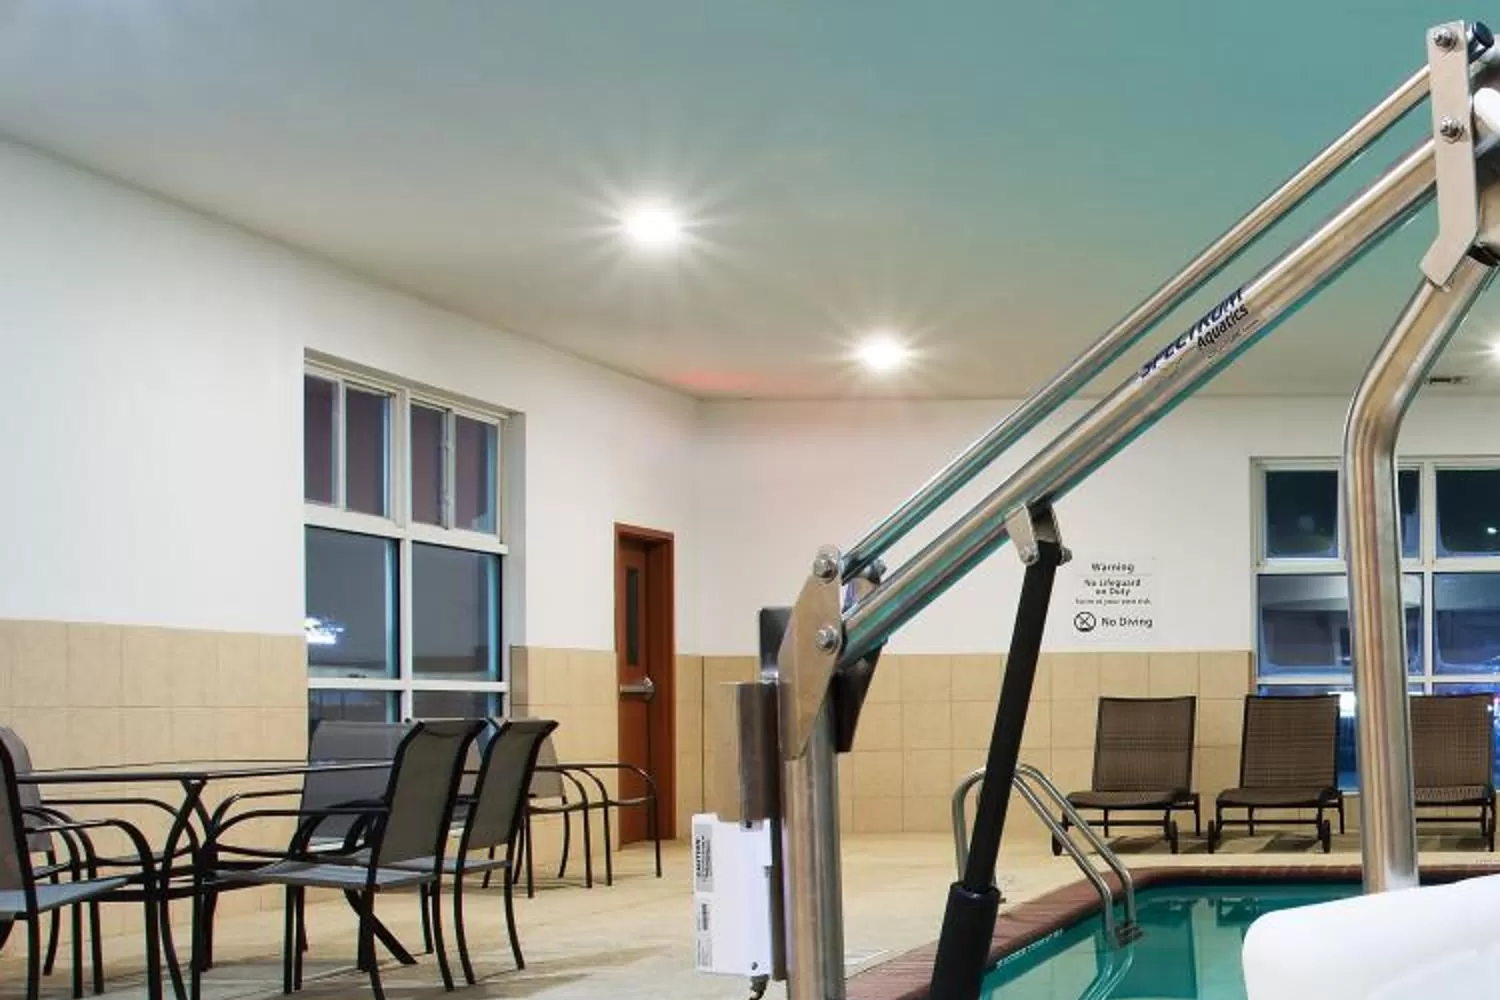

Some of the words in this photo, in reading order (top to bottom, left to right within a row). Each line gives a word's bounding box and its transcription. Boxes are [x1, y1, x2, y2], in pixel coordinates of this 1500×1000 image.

[1197, 304, 1249, 350] Aquatics
[1091, 562, 1134, 574] Warning
[1101, 618, 1117, 627] No
[1119, 617, 1153, 628] Diving
